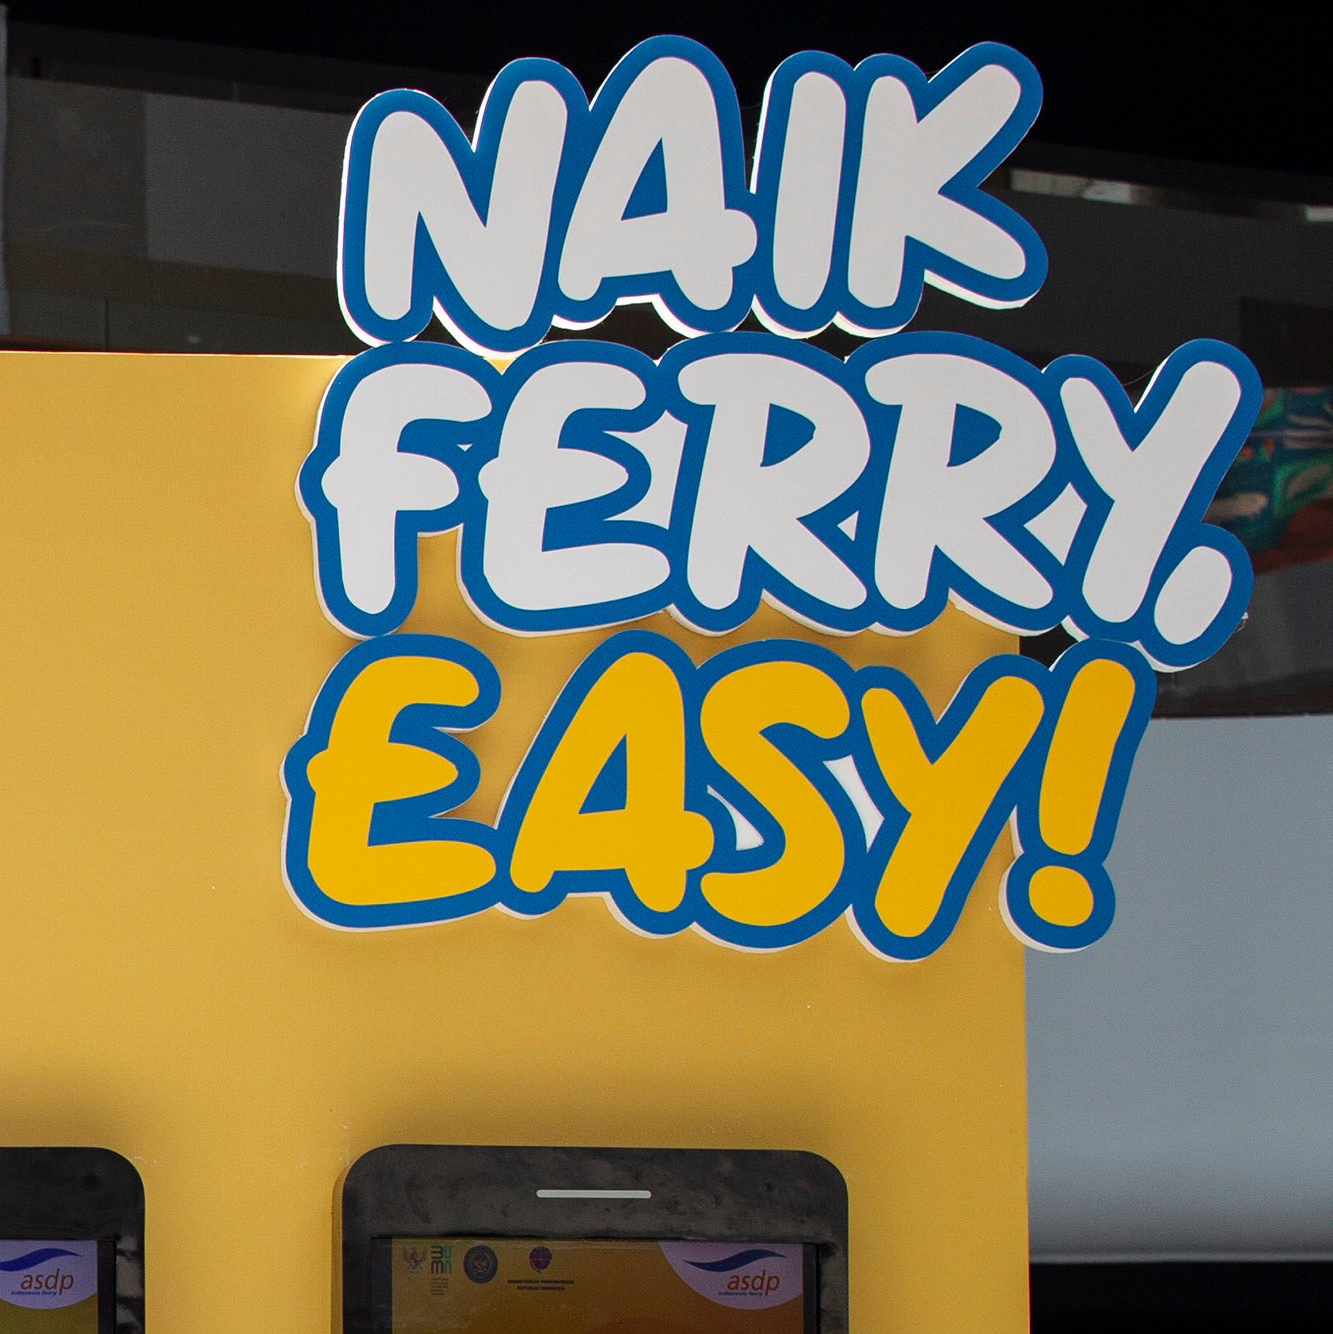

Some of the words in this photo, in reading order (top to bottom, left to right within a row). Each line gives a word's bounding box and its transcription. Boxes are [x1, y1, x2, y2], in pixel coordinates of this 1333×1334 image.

[353, 46, 1035, 340] NAIK
[297, 642, 1145, 945] EASY!
[20, 1268, 75, 1296] asdp
[727, 1269, 781, 1297] asdp
